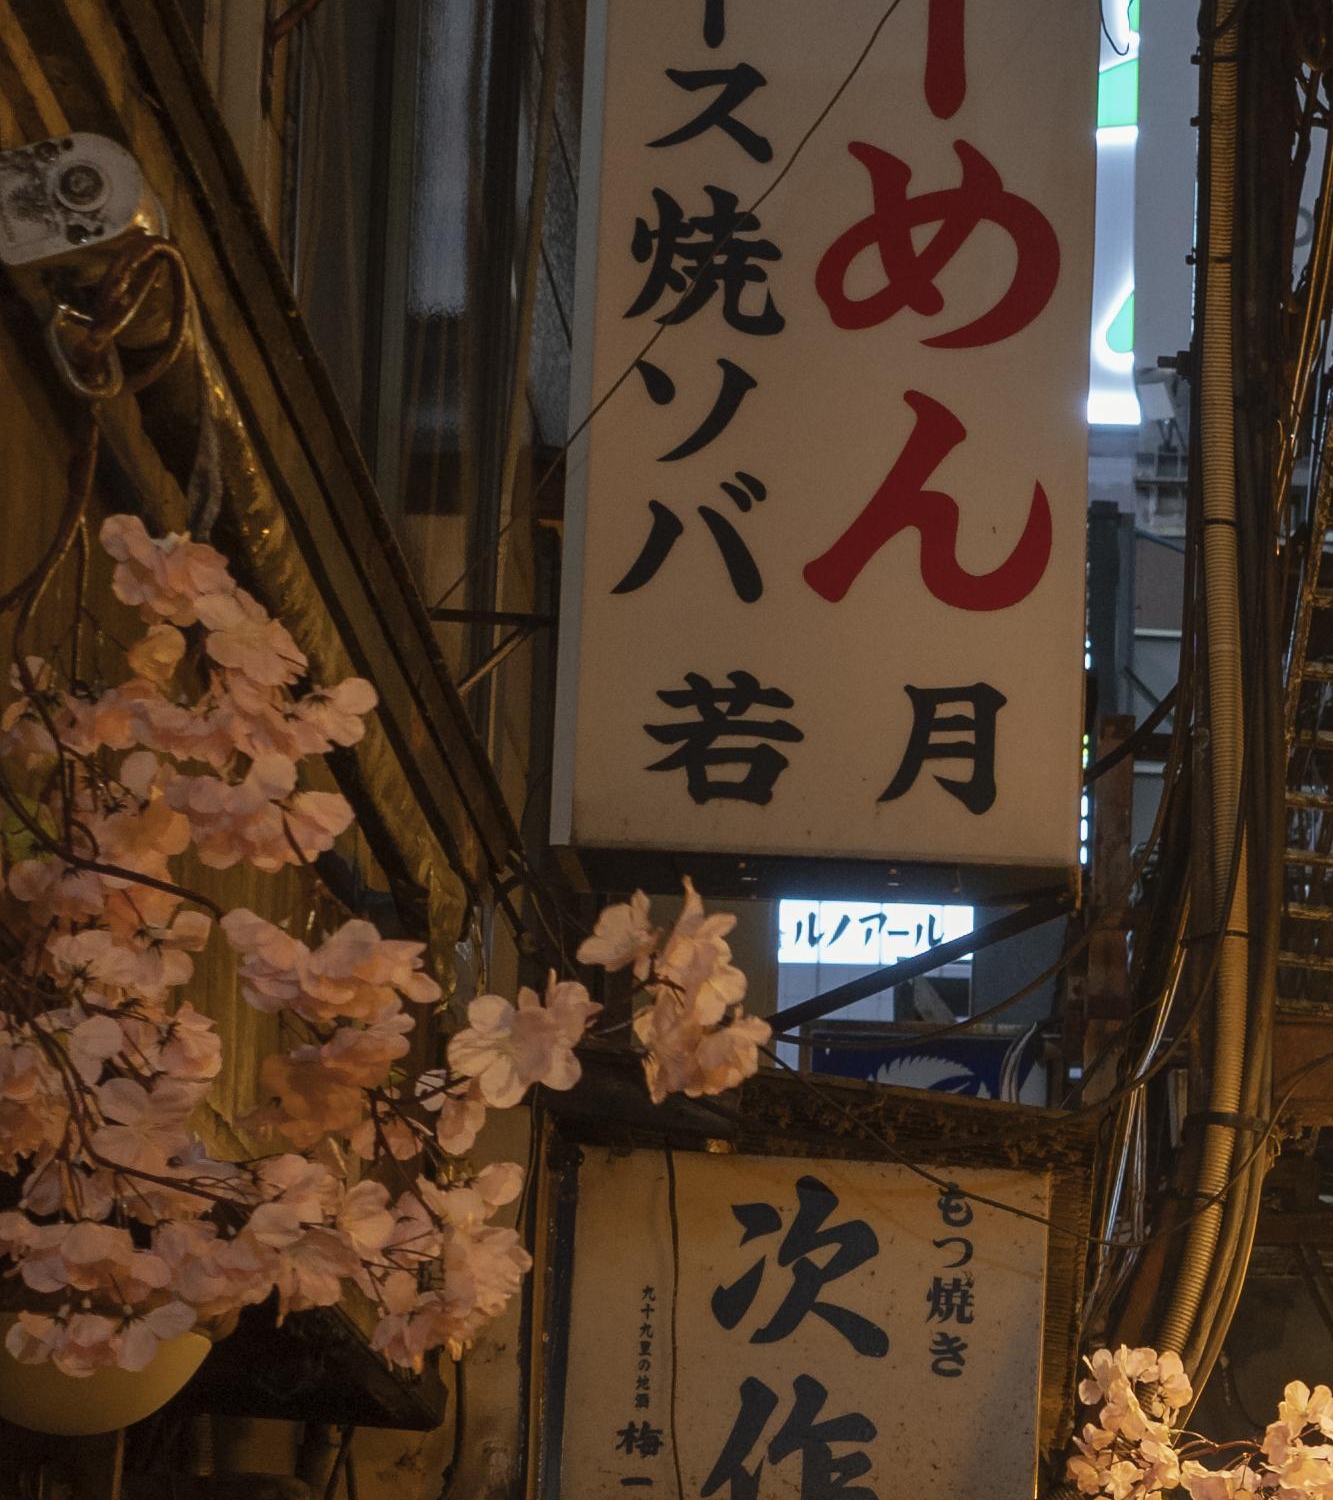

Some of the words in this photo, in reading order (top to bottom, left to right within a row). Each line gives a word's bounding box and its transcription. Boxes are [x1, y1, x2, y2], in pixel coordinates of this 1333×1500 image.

[794, 911, 946, 948] ルノアール
[924, 1181, 976, 1378] もつ焼き
[633, 1284, 657, 1410] 九十九里の地酒
